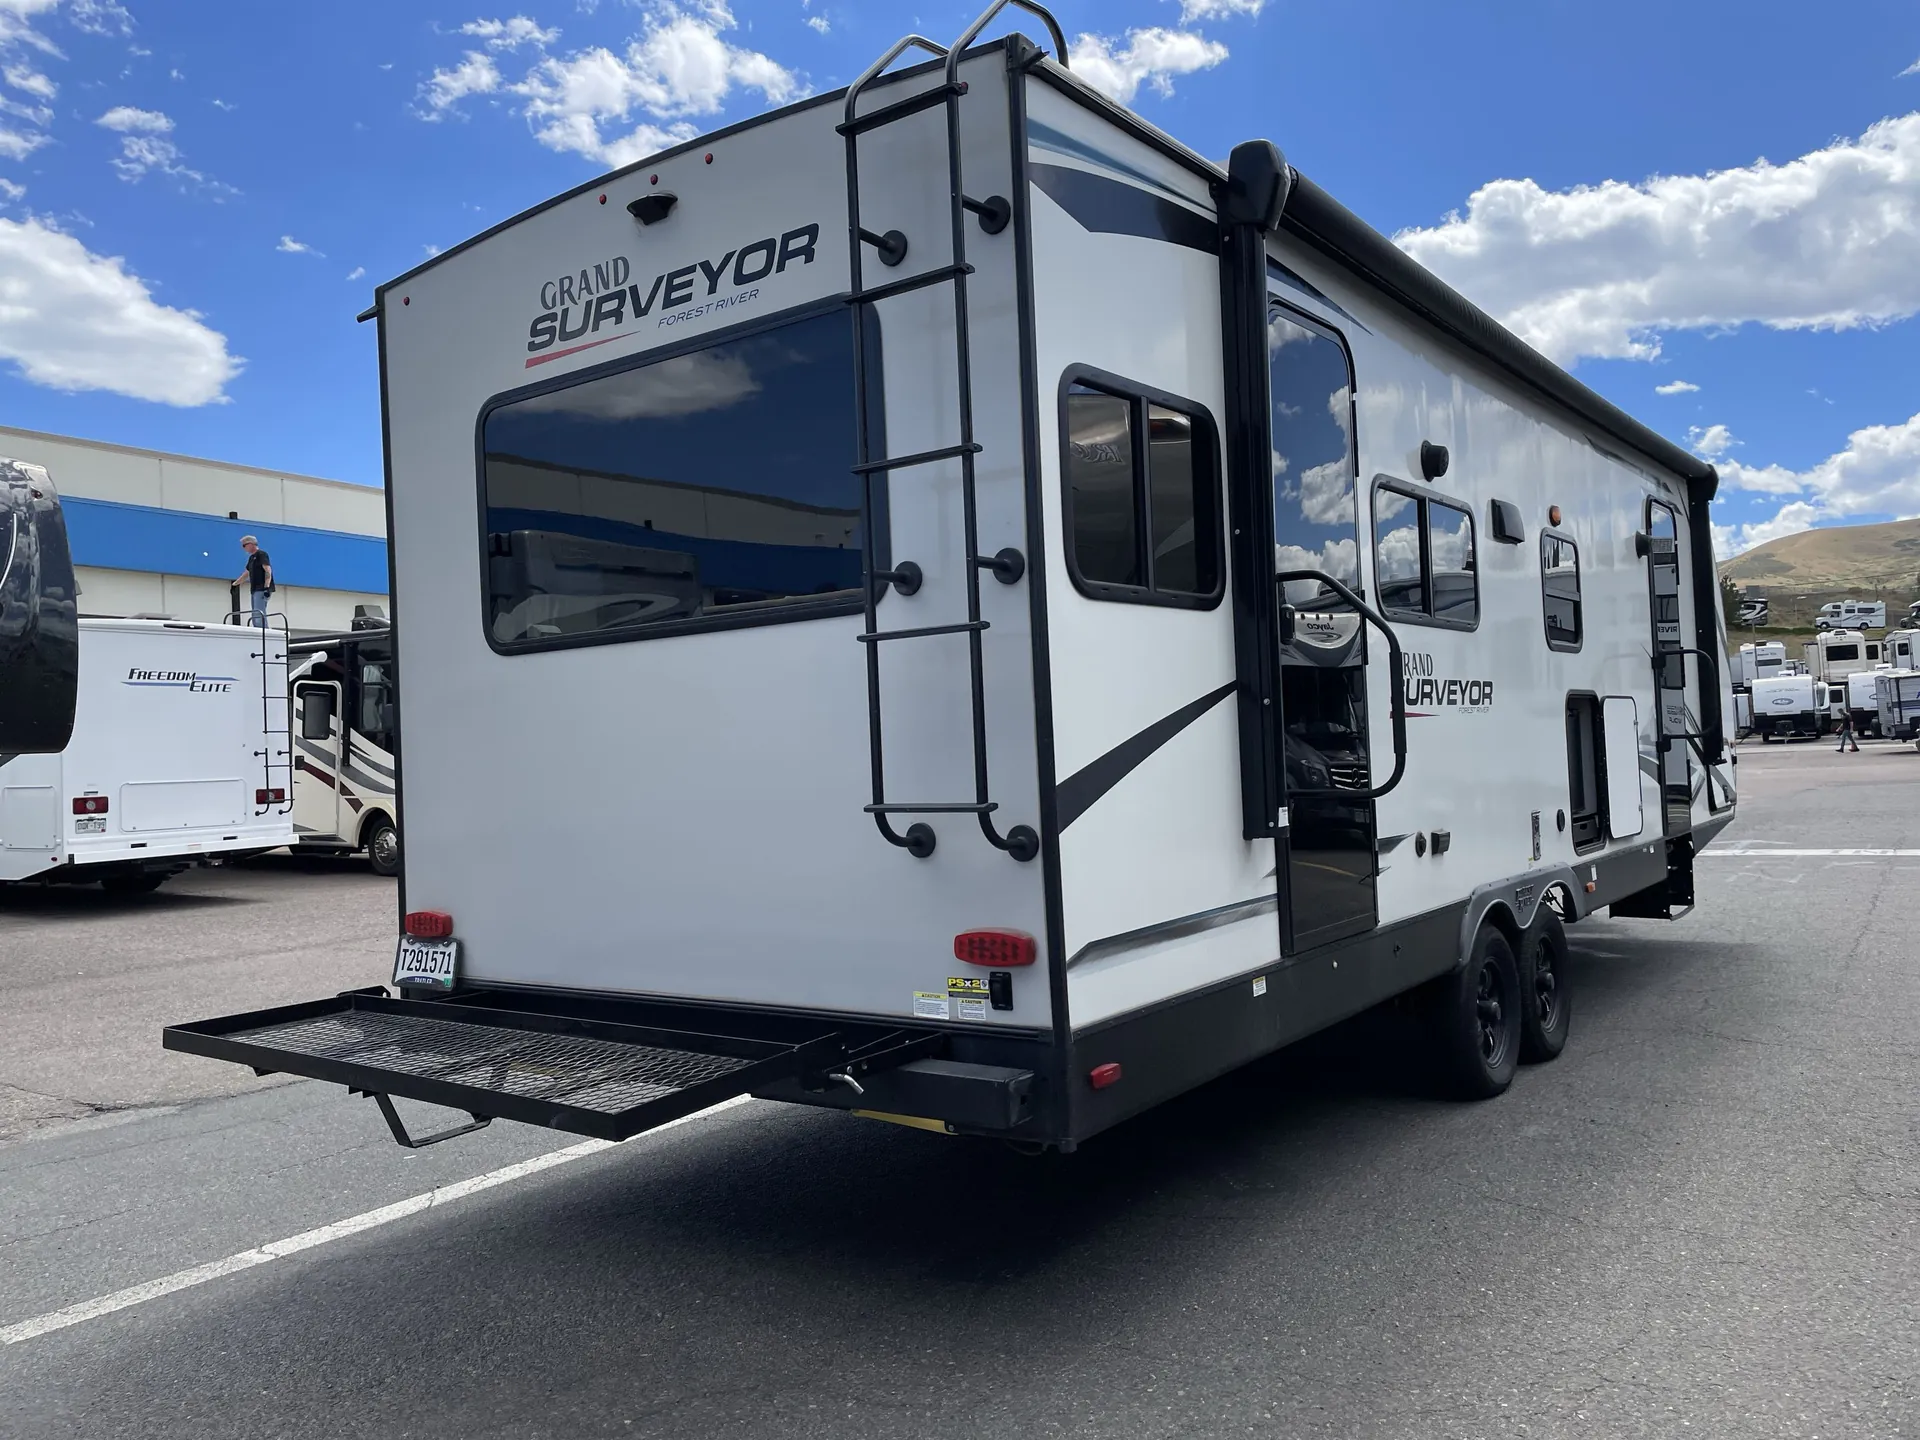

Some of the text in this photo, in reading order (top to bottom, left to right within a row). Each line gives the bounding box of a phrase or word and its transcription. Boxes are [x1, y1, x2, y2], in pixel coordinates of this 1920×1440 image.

[527, 223, 820, 352] SURVEYOR
[540, 256, 630, 310] GRAND
[657, 288, 759, 328] FOREST RIVER
[128, 668, 196, 681] FREEDOM
[1403, 652, 1434, 679] RAND
[1403, 678, 1493, 706] URVEYOR
[401, 948, 452, 975] T291571
[948, 978, 980, 988] PSx2
